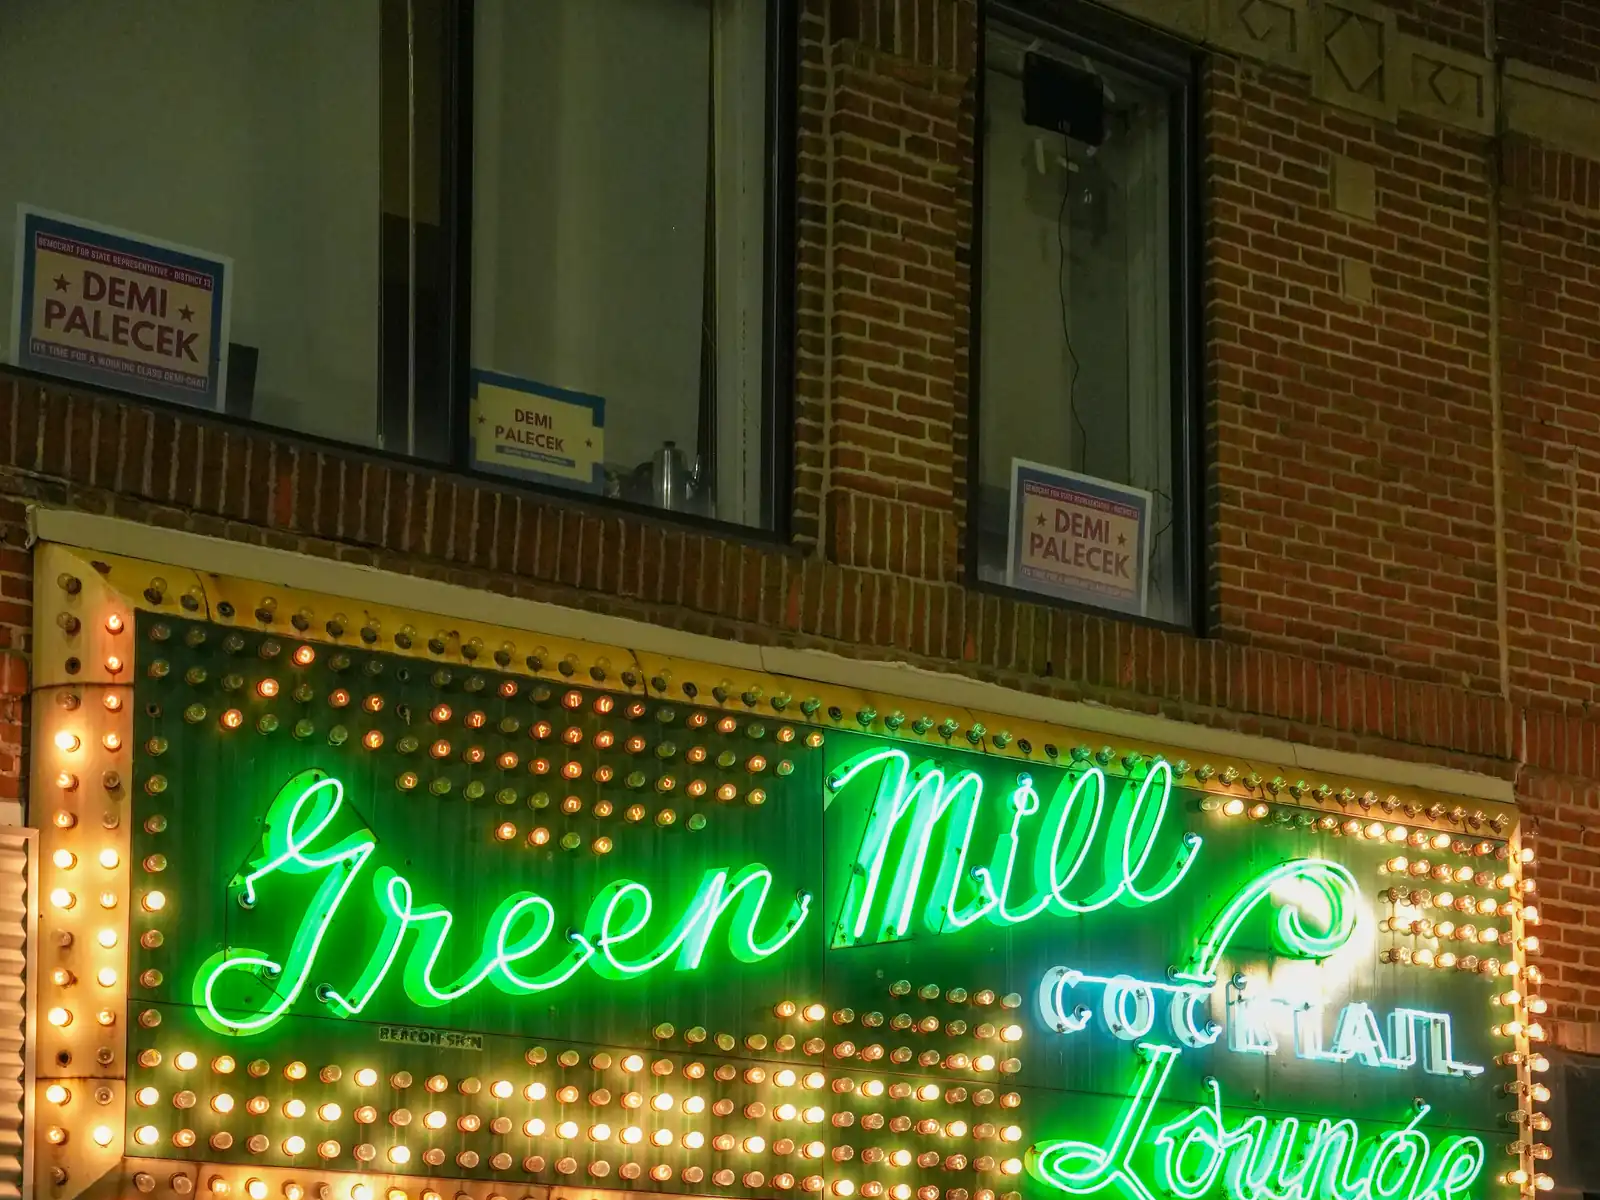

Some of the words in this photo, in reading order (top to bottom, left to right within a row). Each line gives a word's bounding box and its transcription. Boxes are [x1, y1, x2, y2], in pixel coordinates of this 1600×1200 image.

[38, 237, 74, 253] DEMOCRAT
[76, 246, 90, 257] FOR
[91, 249, 111, 263] STATE
[113, 254, 168, 277] REPRESENTATIVE
[82, 270, 168, 318] DEMI
[44, 298, 199, 363] PALECEK
[49, 345, 69, 358] TIME
[71, 351, 87, 361] FOR
[88, 355, 96, 365] A
[98, 357, 135, 373] WORKING
[137, 364, 162, 380] CLASS
[515, 408, 552, 430] DEMI
[495, 425, 565, 452] PALECEK
[1055, 508, 1110, 544] DEMI
[1030, 532, 1130, 579] PALECEK
[193, 768, 813, 1036] Green
[824, 747, 1202, 950] Mill
[380, 1027, 441, 1045] BEACON
[447, 1033, 482, 1049] SIGN
